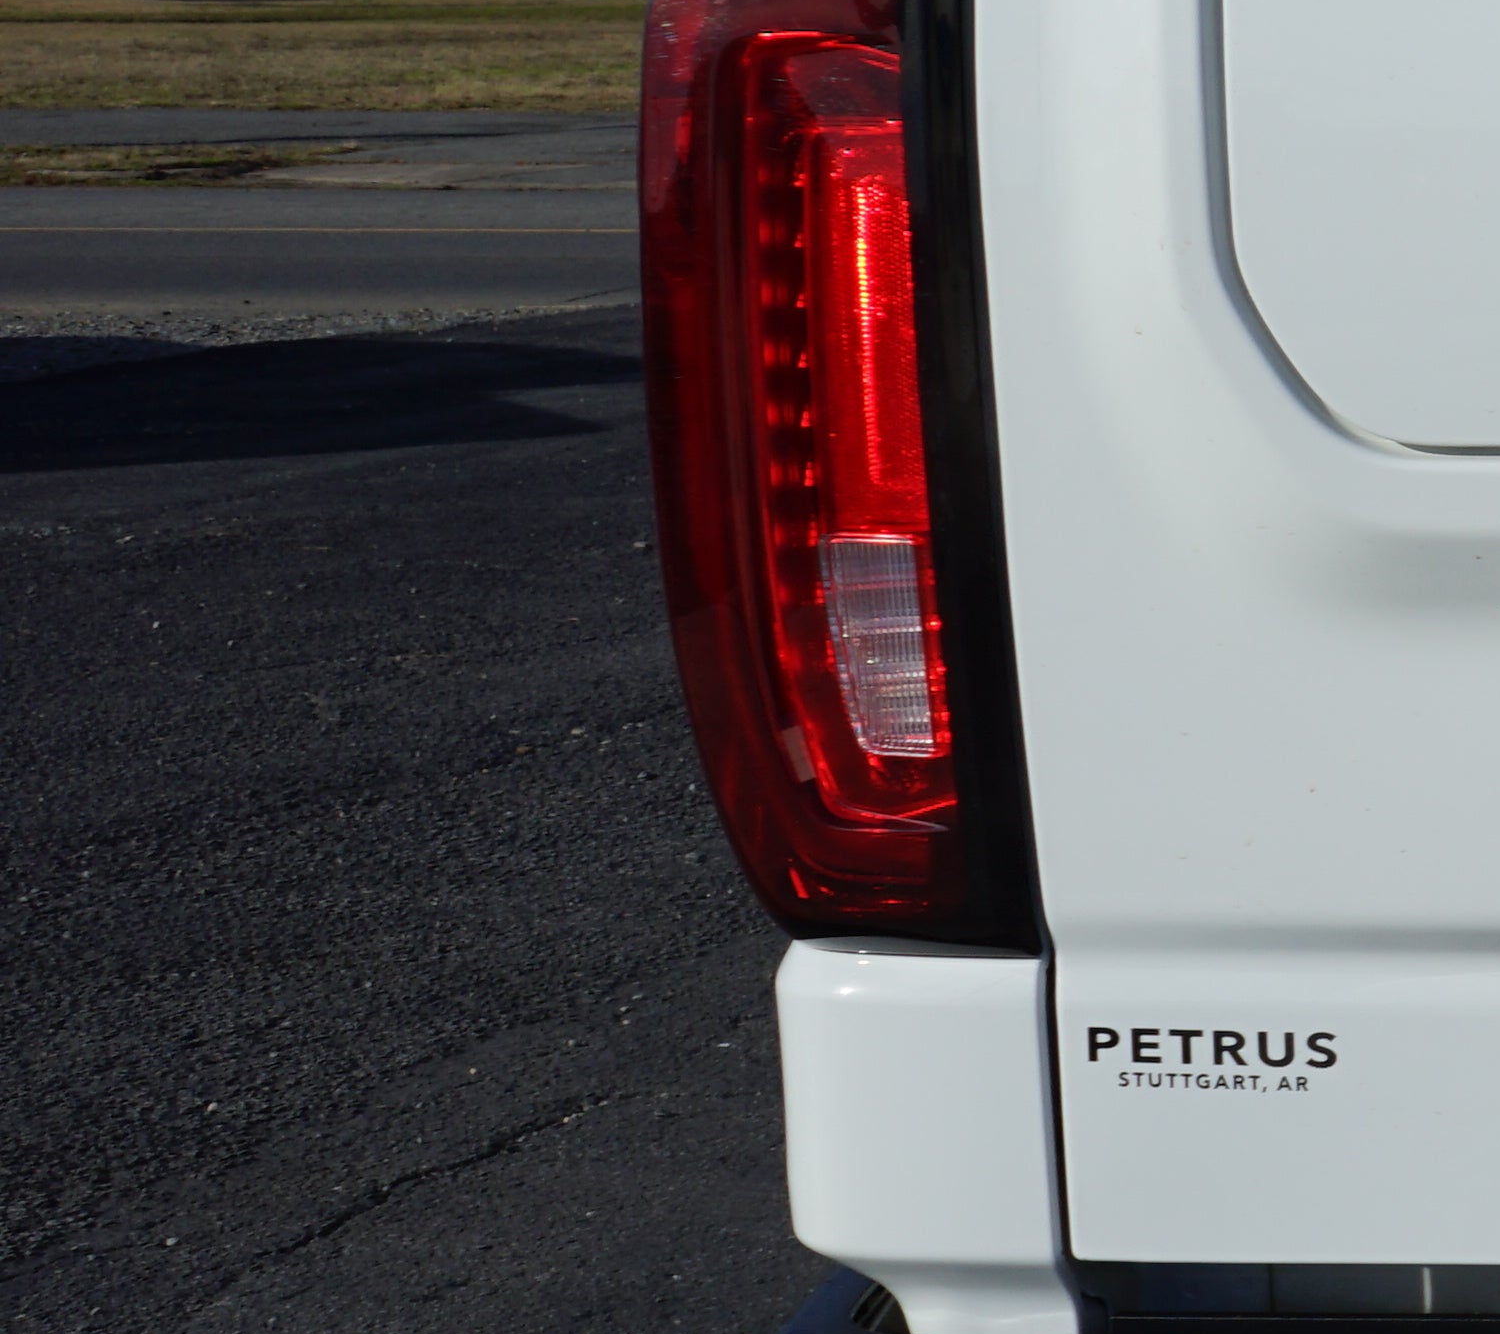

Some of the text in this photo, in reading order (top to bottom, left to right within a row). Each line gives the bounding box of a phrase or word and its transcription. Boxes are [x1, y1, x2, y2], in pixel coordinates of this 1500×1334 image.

[1087, 1026, 1338, 1069] PETRUS
[1118, 1071, 1310, 1093] STUTTGART, AR
